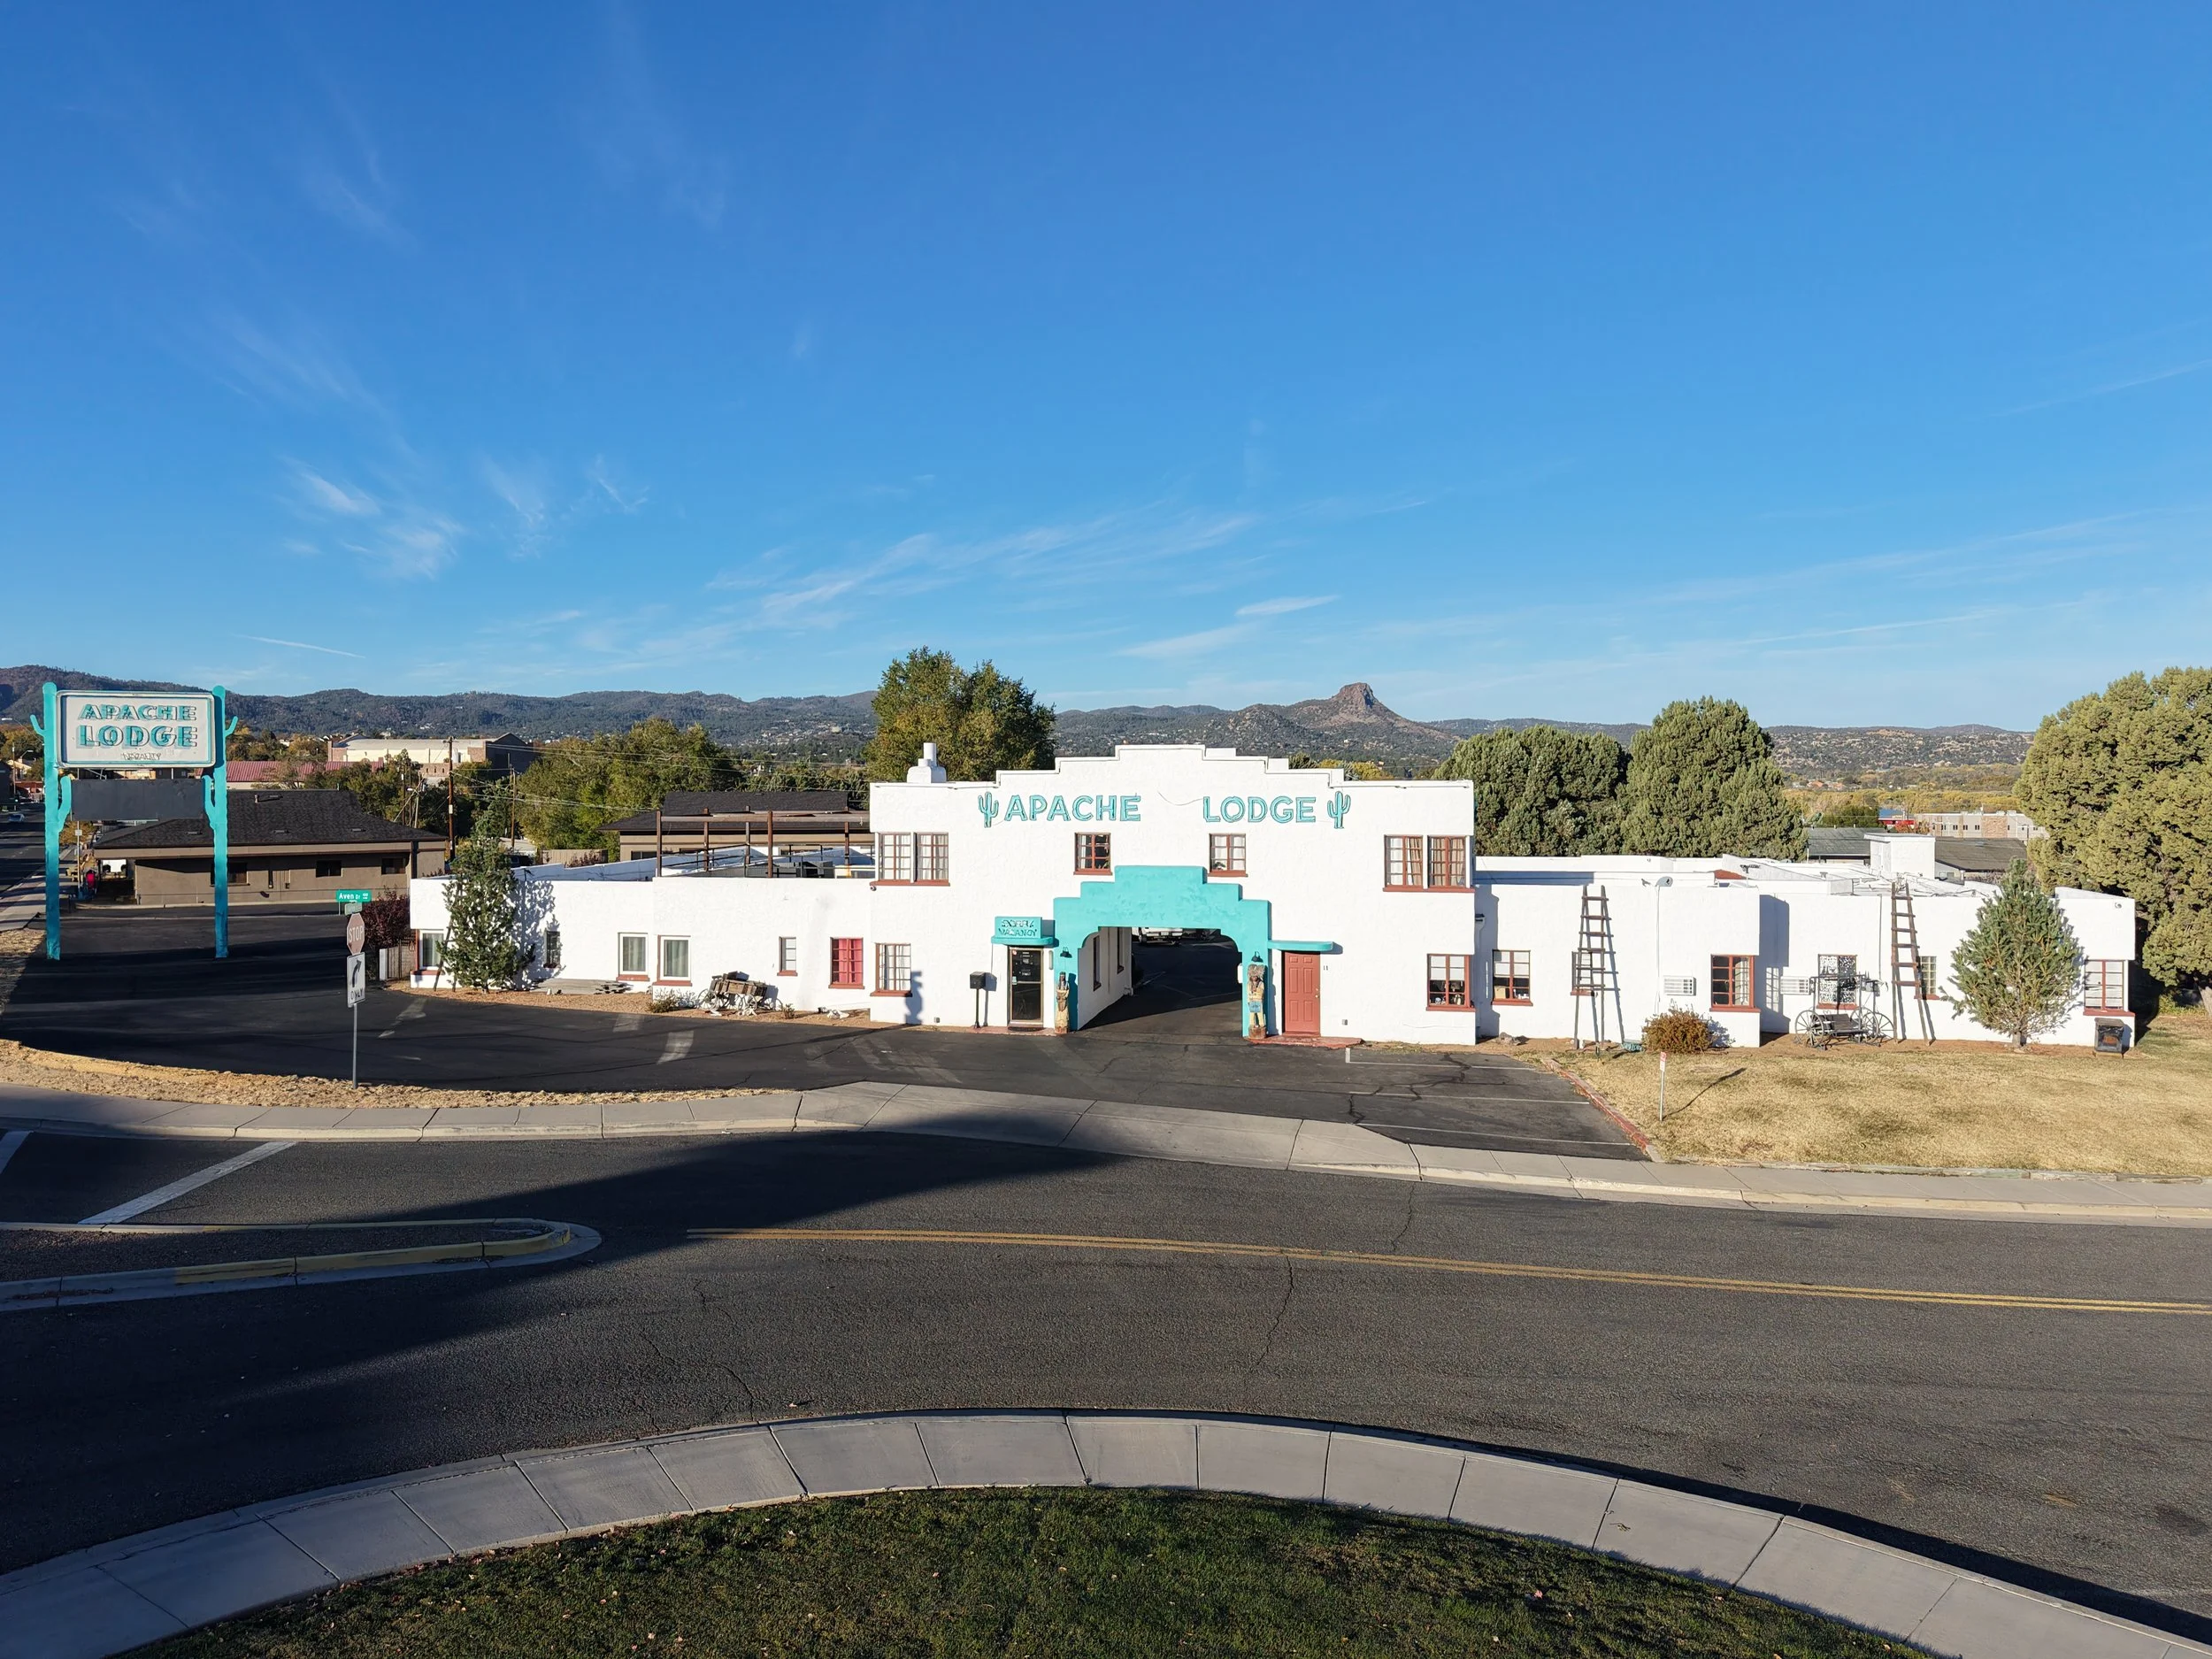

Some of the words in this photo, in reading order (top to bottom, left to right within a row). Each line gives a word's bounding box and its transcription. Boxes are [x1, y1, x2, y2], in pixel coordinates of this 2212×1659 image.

[78, 703, 197, 721] APACHE
[76, 725, 198, 749] LODGE
[1004, 794, 1141, 822] APACHE
[1203, 795, 1317, 824] LODGE
[349, 925, 365, 943] STOP
[349, 987, 364, 1001] ONLY
